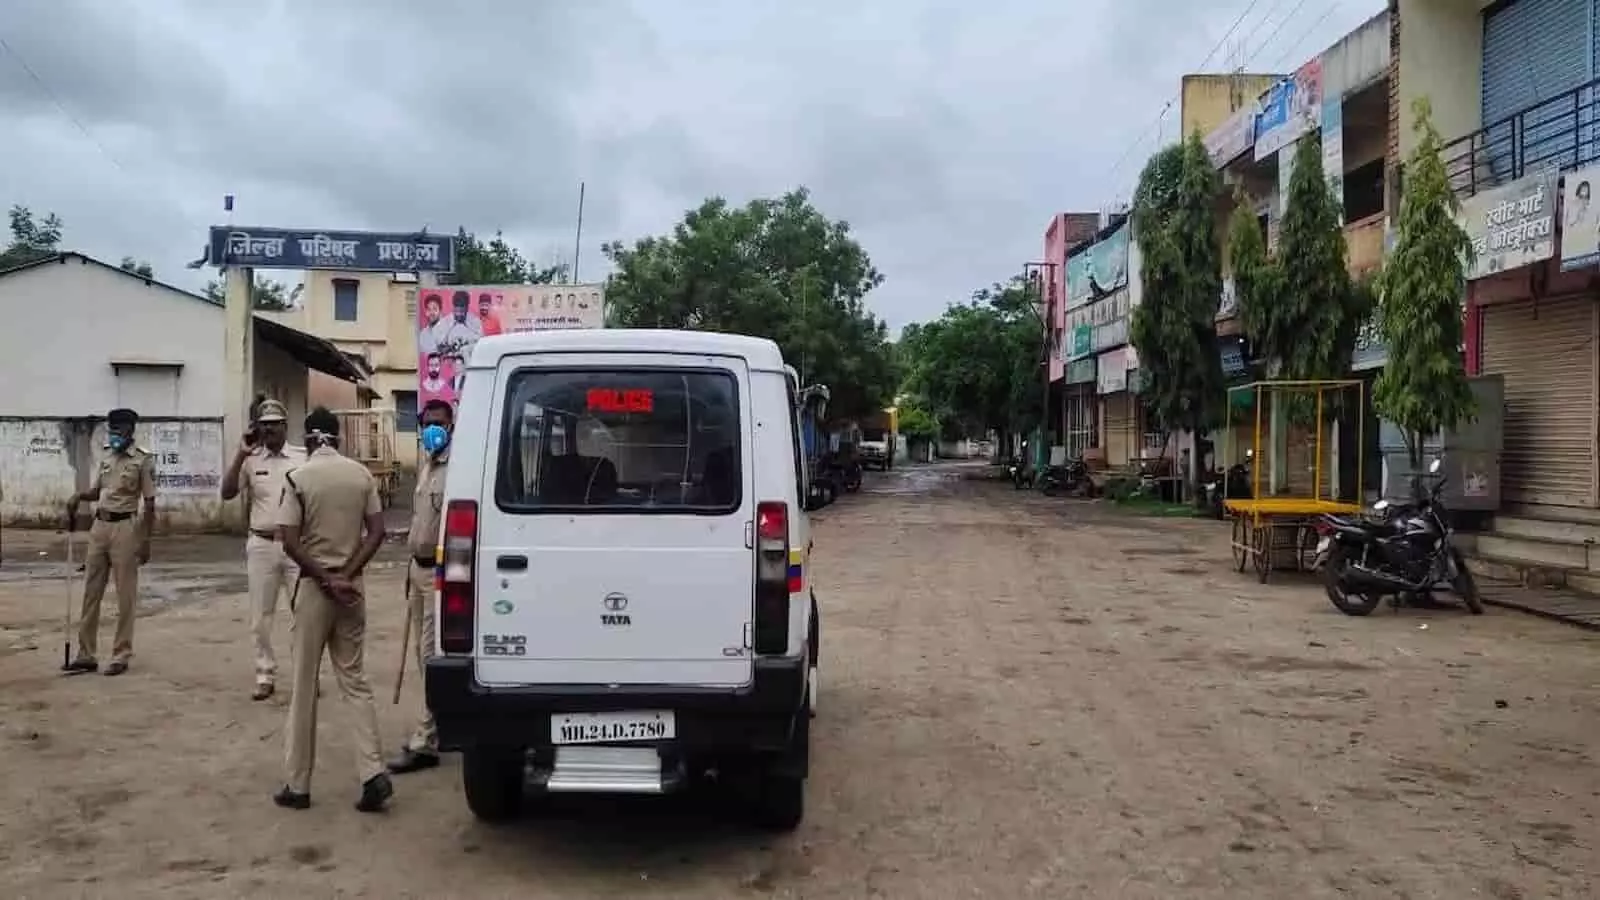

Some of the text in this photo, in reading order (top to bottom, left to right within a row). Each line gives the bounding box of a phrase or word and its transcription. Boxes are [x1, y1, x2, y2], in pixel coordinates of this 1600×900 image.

[227, 232, 286, 258] जिल्हा
[298, 234, 360, 259] परिषद
[587, 387, 653, 412] POLICE
[601, 614, 631, 626] TATA
[483, 634, 527, 645] SUMO
[483, 645, 526, 656] GOLD
[561, 721, 665, 741] MH.24.D.7780
